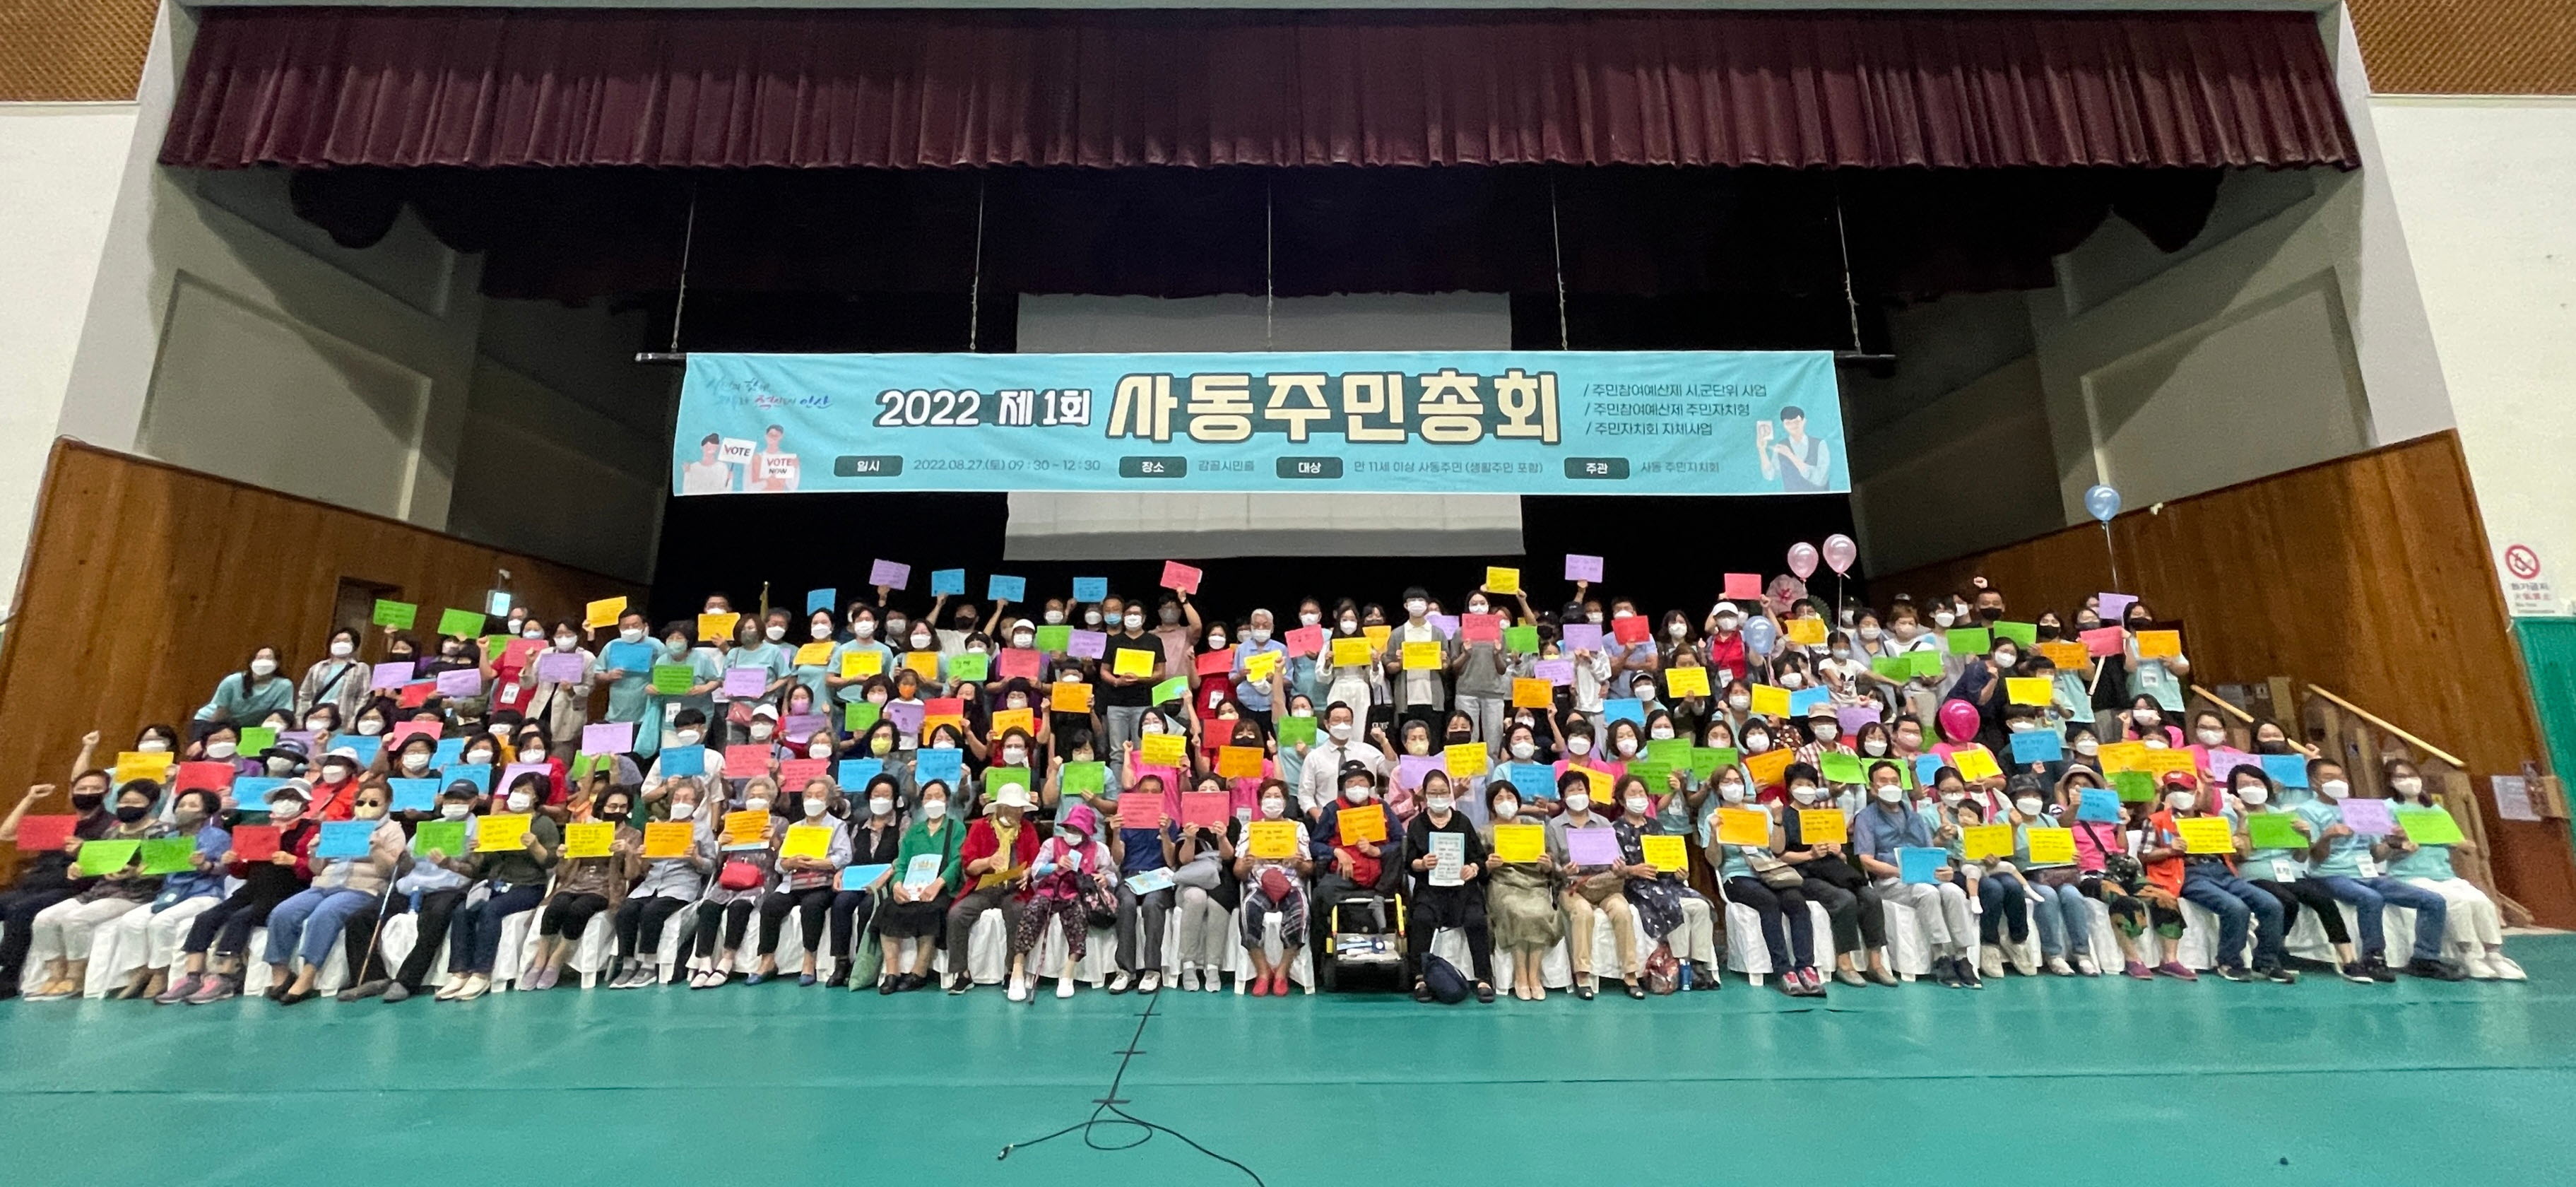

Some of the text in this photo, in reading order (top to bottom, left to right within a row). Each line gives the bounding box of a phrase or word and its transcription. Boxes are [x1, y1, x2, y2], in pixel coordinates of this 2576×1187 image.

[1593, 384, 1682, 397] 주민참여예산제
[1742, 384, 1766, 397] 사업
[878, 390, 1091, 425] 2022 제 1회
[1107, 370, 1559, 443] 사동주민총회
[1593, 403, 1683, 416] 주민참여예산제
[1686, 403, 1750, 417] 주민자치형
[1595, 422, 1658, 435] 주민자치회
[1662, 422, 1713, 435] 자체사업
[723, 444, 751, 457] VOTE
[767, 458, 792, 467] VOTE
[857, 461, 880, 472] 일시
[1141, 461, 1164, 473] 장소
[1298, 461, 1321, 473] 대상
[1354, 461, 1364, 472] 만
[1369, 461, 1389, 472] 11세
[1393, 461, 1414, 473] 이상
[1418, 461, 1462, 473] 사동주민
[1585, 463, 1609, 474] 주관
[1641, 461, 1719, 473] 사동 주민자치회
